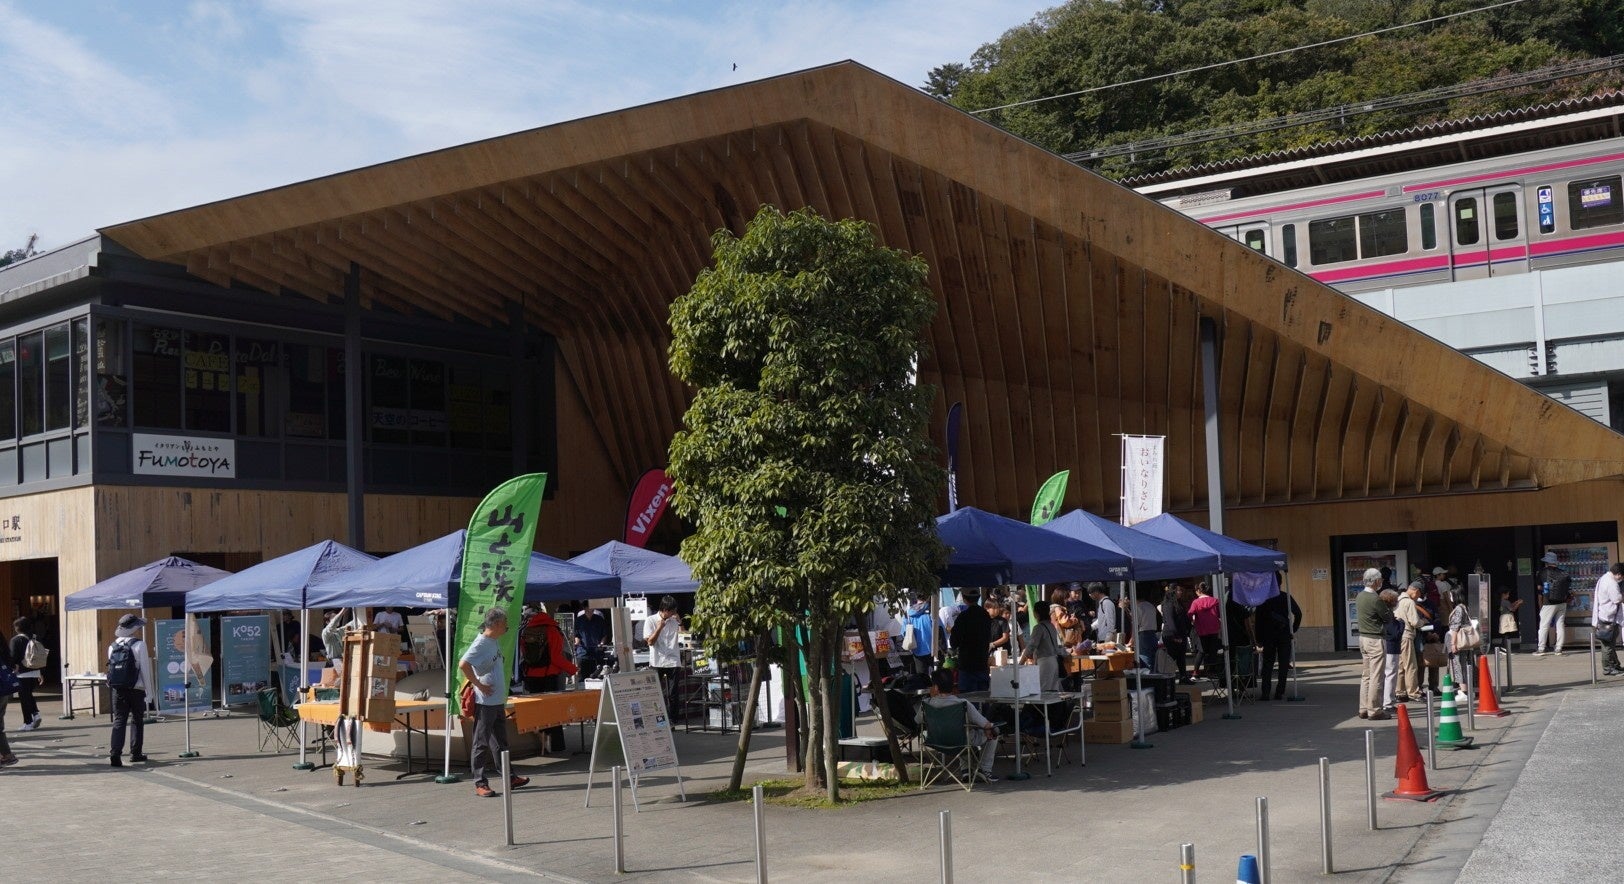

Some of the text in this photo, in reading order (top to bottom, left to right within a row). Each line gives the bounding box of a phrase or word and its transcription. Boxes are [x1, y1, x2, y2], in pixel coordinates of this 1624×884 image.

[1413, 192, 1439, 203] 8077
[1139, 447, 1150, 511] おいなりさん
[631, 483, 669, 534] Vixen
